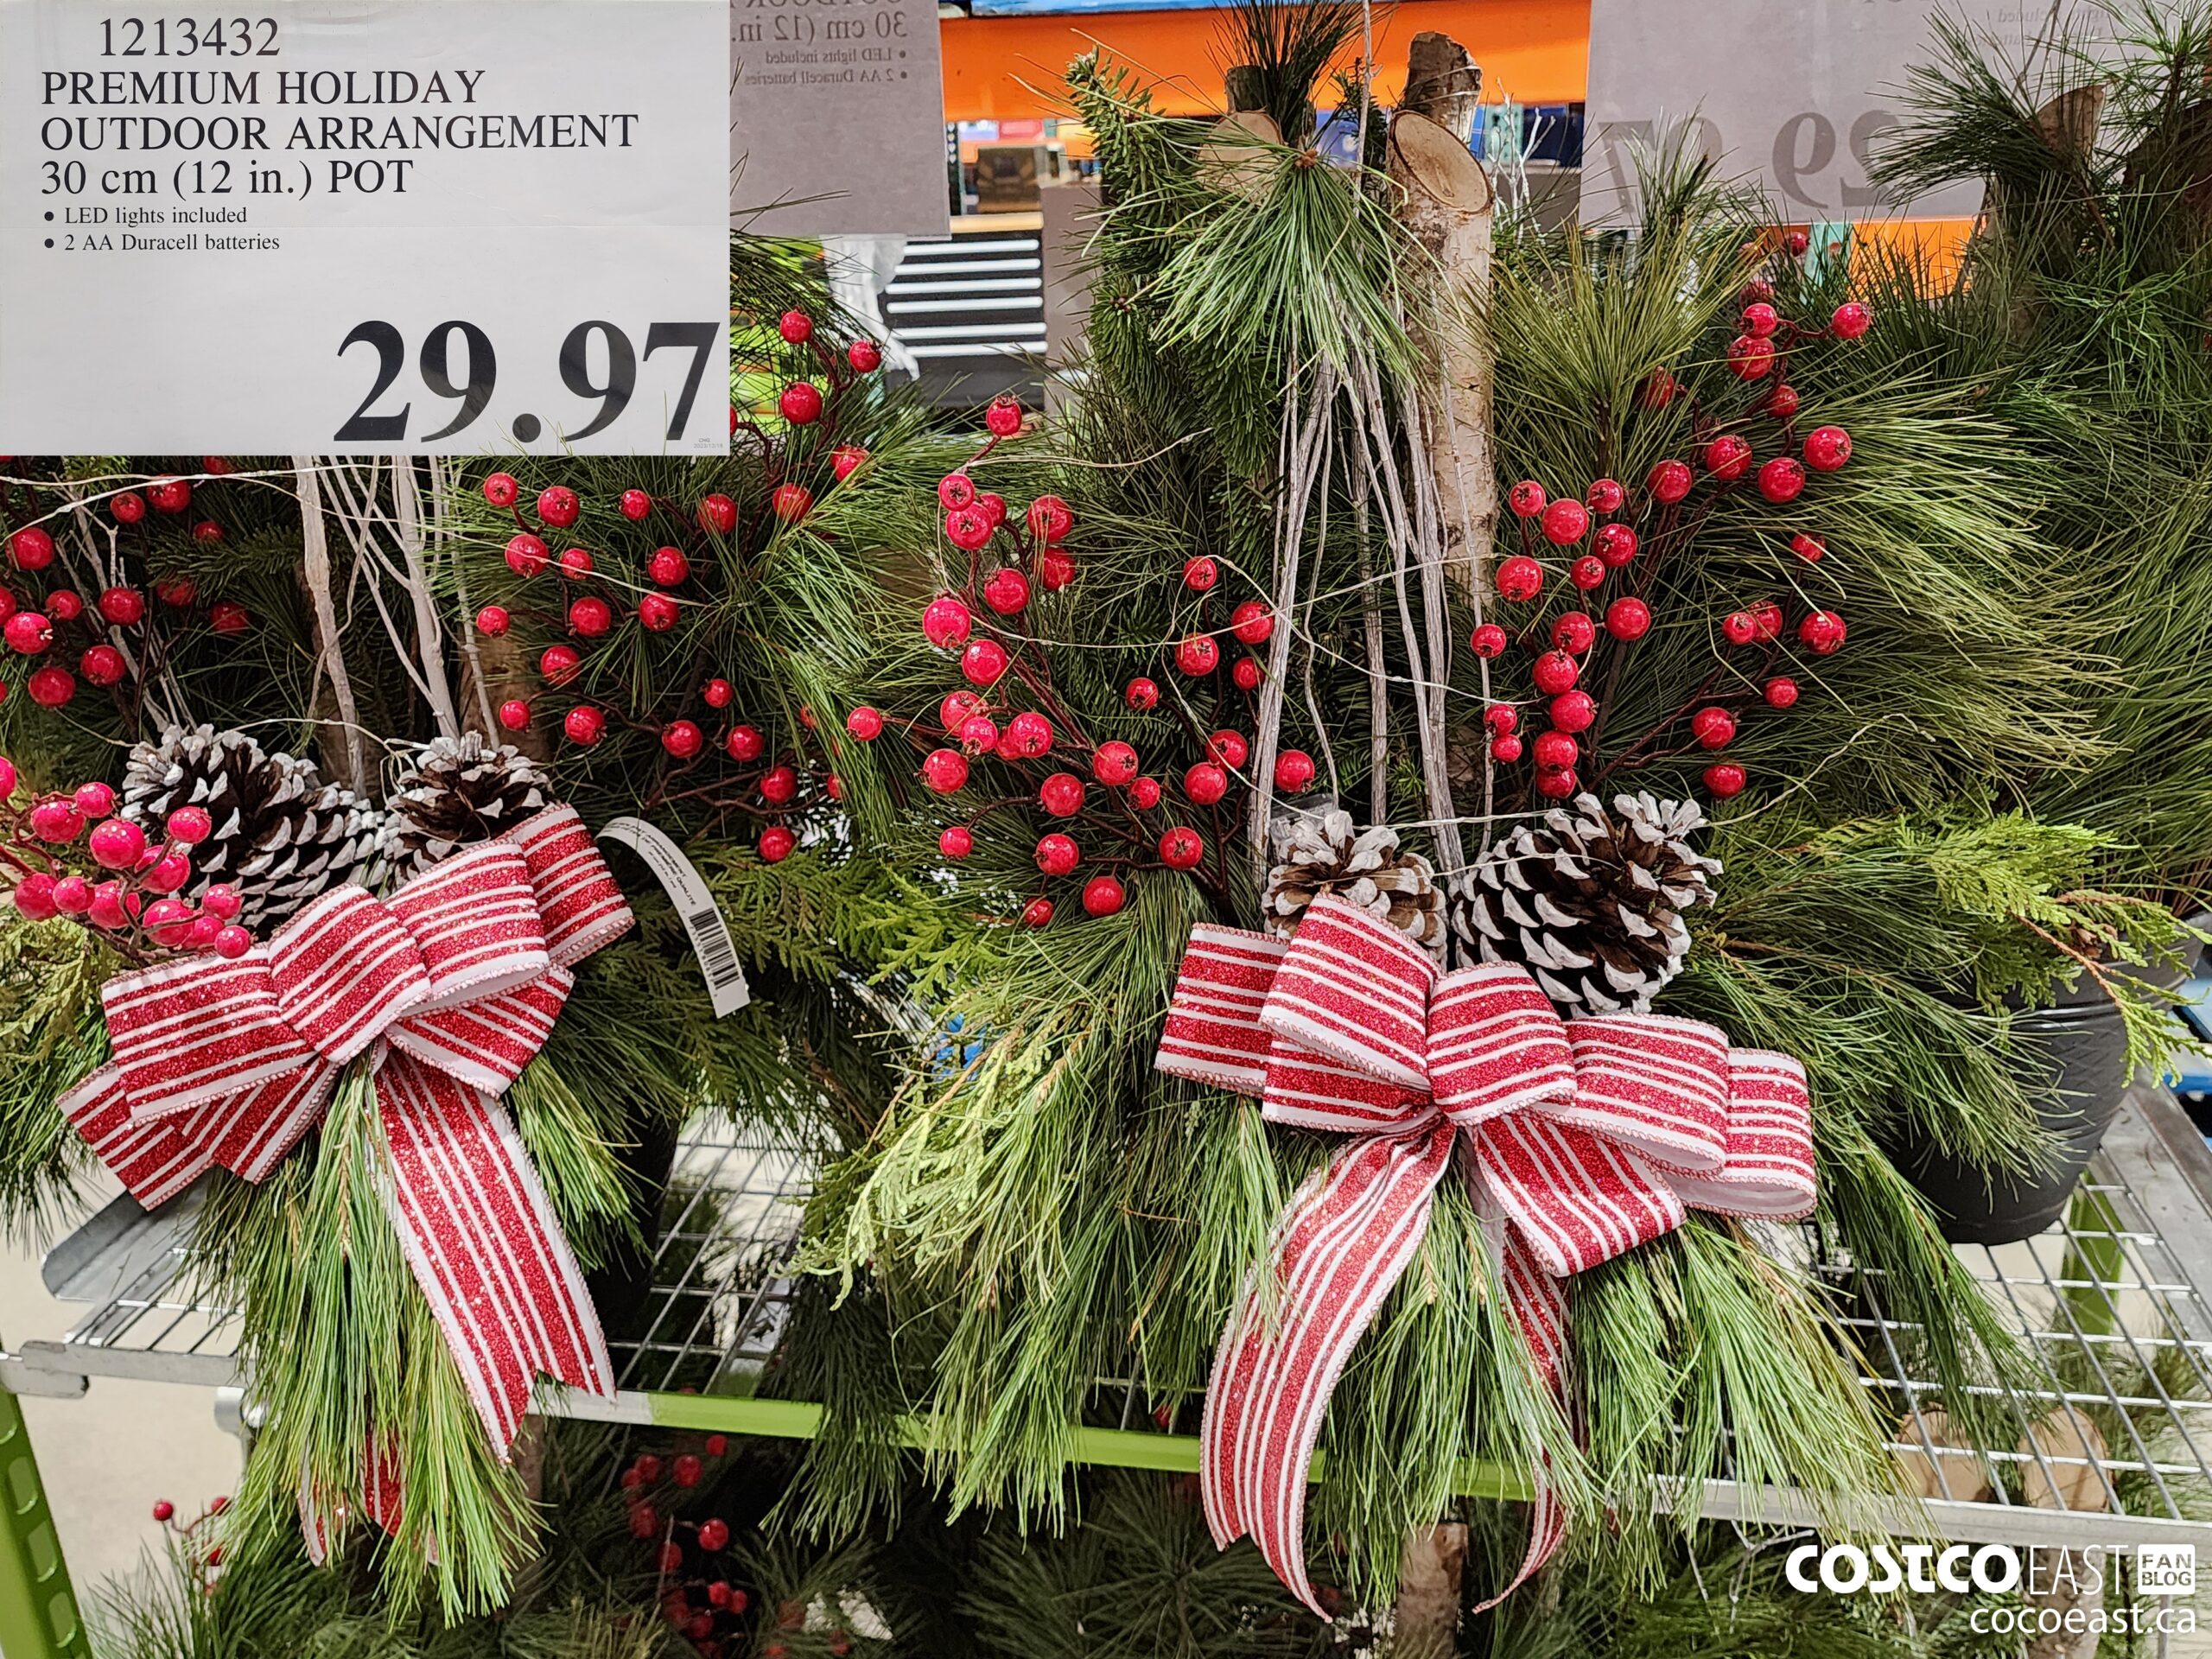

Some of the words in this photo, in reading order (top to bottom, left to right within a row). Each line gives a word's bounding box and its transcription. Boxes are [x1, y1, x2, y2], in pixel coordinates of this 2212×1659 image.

[101, 17, 280, 57] 1213432
[41, 71, 259, 105] PREMIUM
[276, 70, 486, 105] HOLIDAY
[41, 116, 270, 151] OUTDOOR
[285, 114, 639, 149] ARRANGEMENT
[41, 160, 86, 194] 30
[102, 169, 157, 194] cm
[174, 160, 232, 201] (12
[250, 160, 312, 201] in.)
[328, 159, 414, 194] POT
[65, 207, 108, 224] LED
[116, 207, 165, 228] lights
[172, 207, 247, 223] included
[65, 233, 75, 251] 2
[83, 234, 114, 251] AA
[121, 233, 198, 251] Duracell
[205, 232, 280, 250] batteries
[334, 320, 721, 443] 29.97
